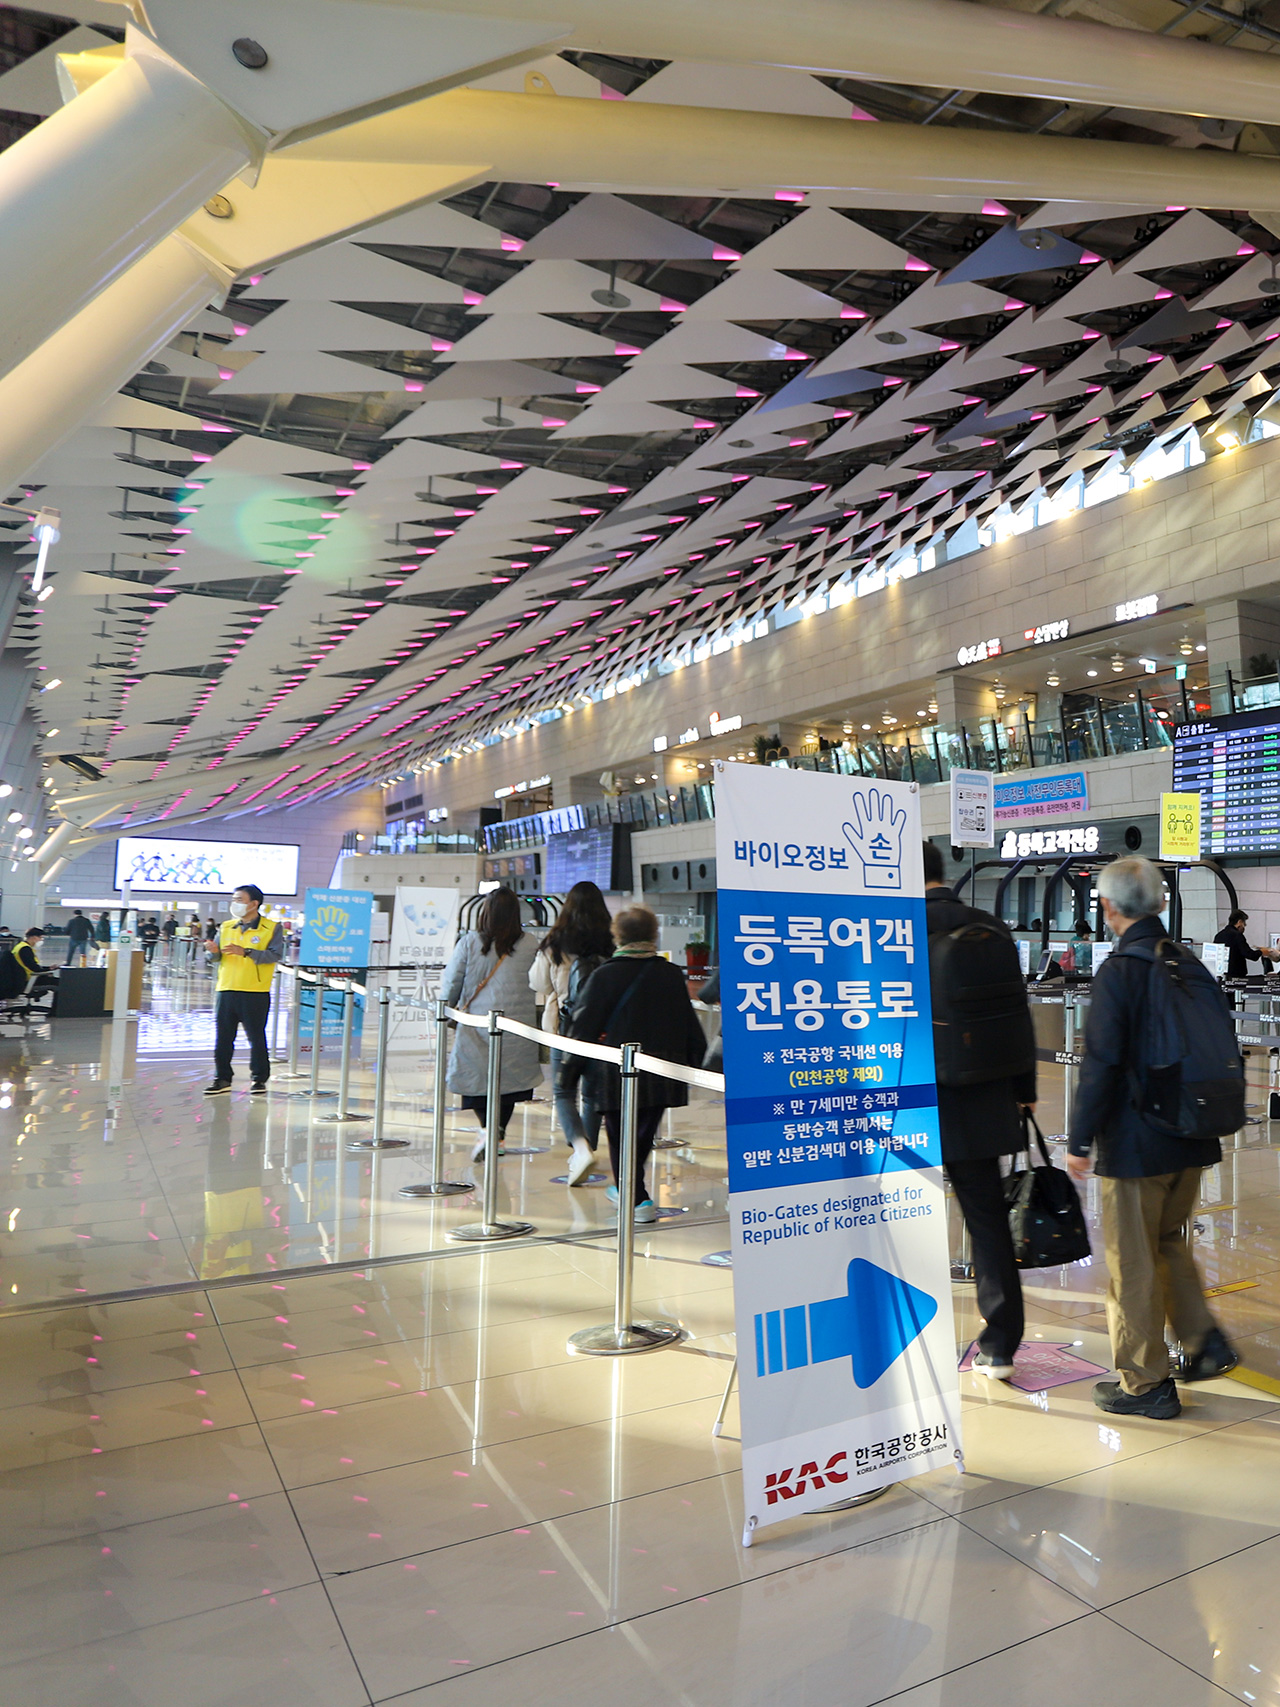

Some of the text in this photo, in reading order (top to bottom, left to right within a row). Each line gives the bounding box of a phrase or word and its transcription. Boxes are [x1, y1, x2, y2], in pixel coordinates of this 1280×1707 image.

[972, 792, 988, 800] 신분증
[994, 777, 1082, 803] 이오정보 사전무인등록대
[958, 808, 974, 816] 탑승권
[734, 832, 893, 871] 바이오정보 손
[734, 914, 915, 966] 등록여객
[736, 979, 919, 1032] 전용통로
[780, 1043, 903, 1065] 전국공항 국내선 이용
[789, 1065, 883, 1088] (인천공항 제외)
[790, 1092, 899, 1116] 만 7세미만 승객과
[783, 1116, 893, 1141] 동반승객 분께서는
[743, 1133, 929, 1168] 일반 신분검색대 이용 바랍니다
[741, 1187, 923, 1226] Bio-Gates designated for
[742, 1203, 932, 1245] Republic of Korea Citizens
[764, 1424, 948, 1506] KAC 한국공항공사
[856, 1442, 948, 1476] KOREA AIRPORTS CORPORATION
